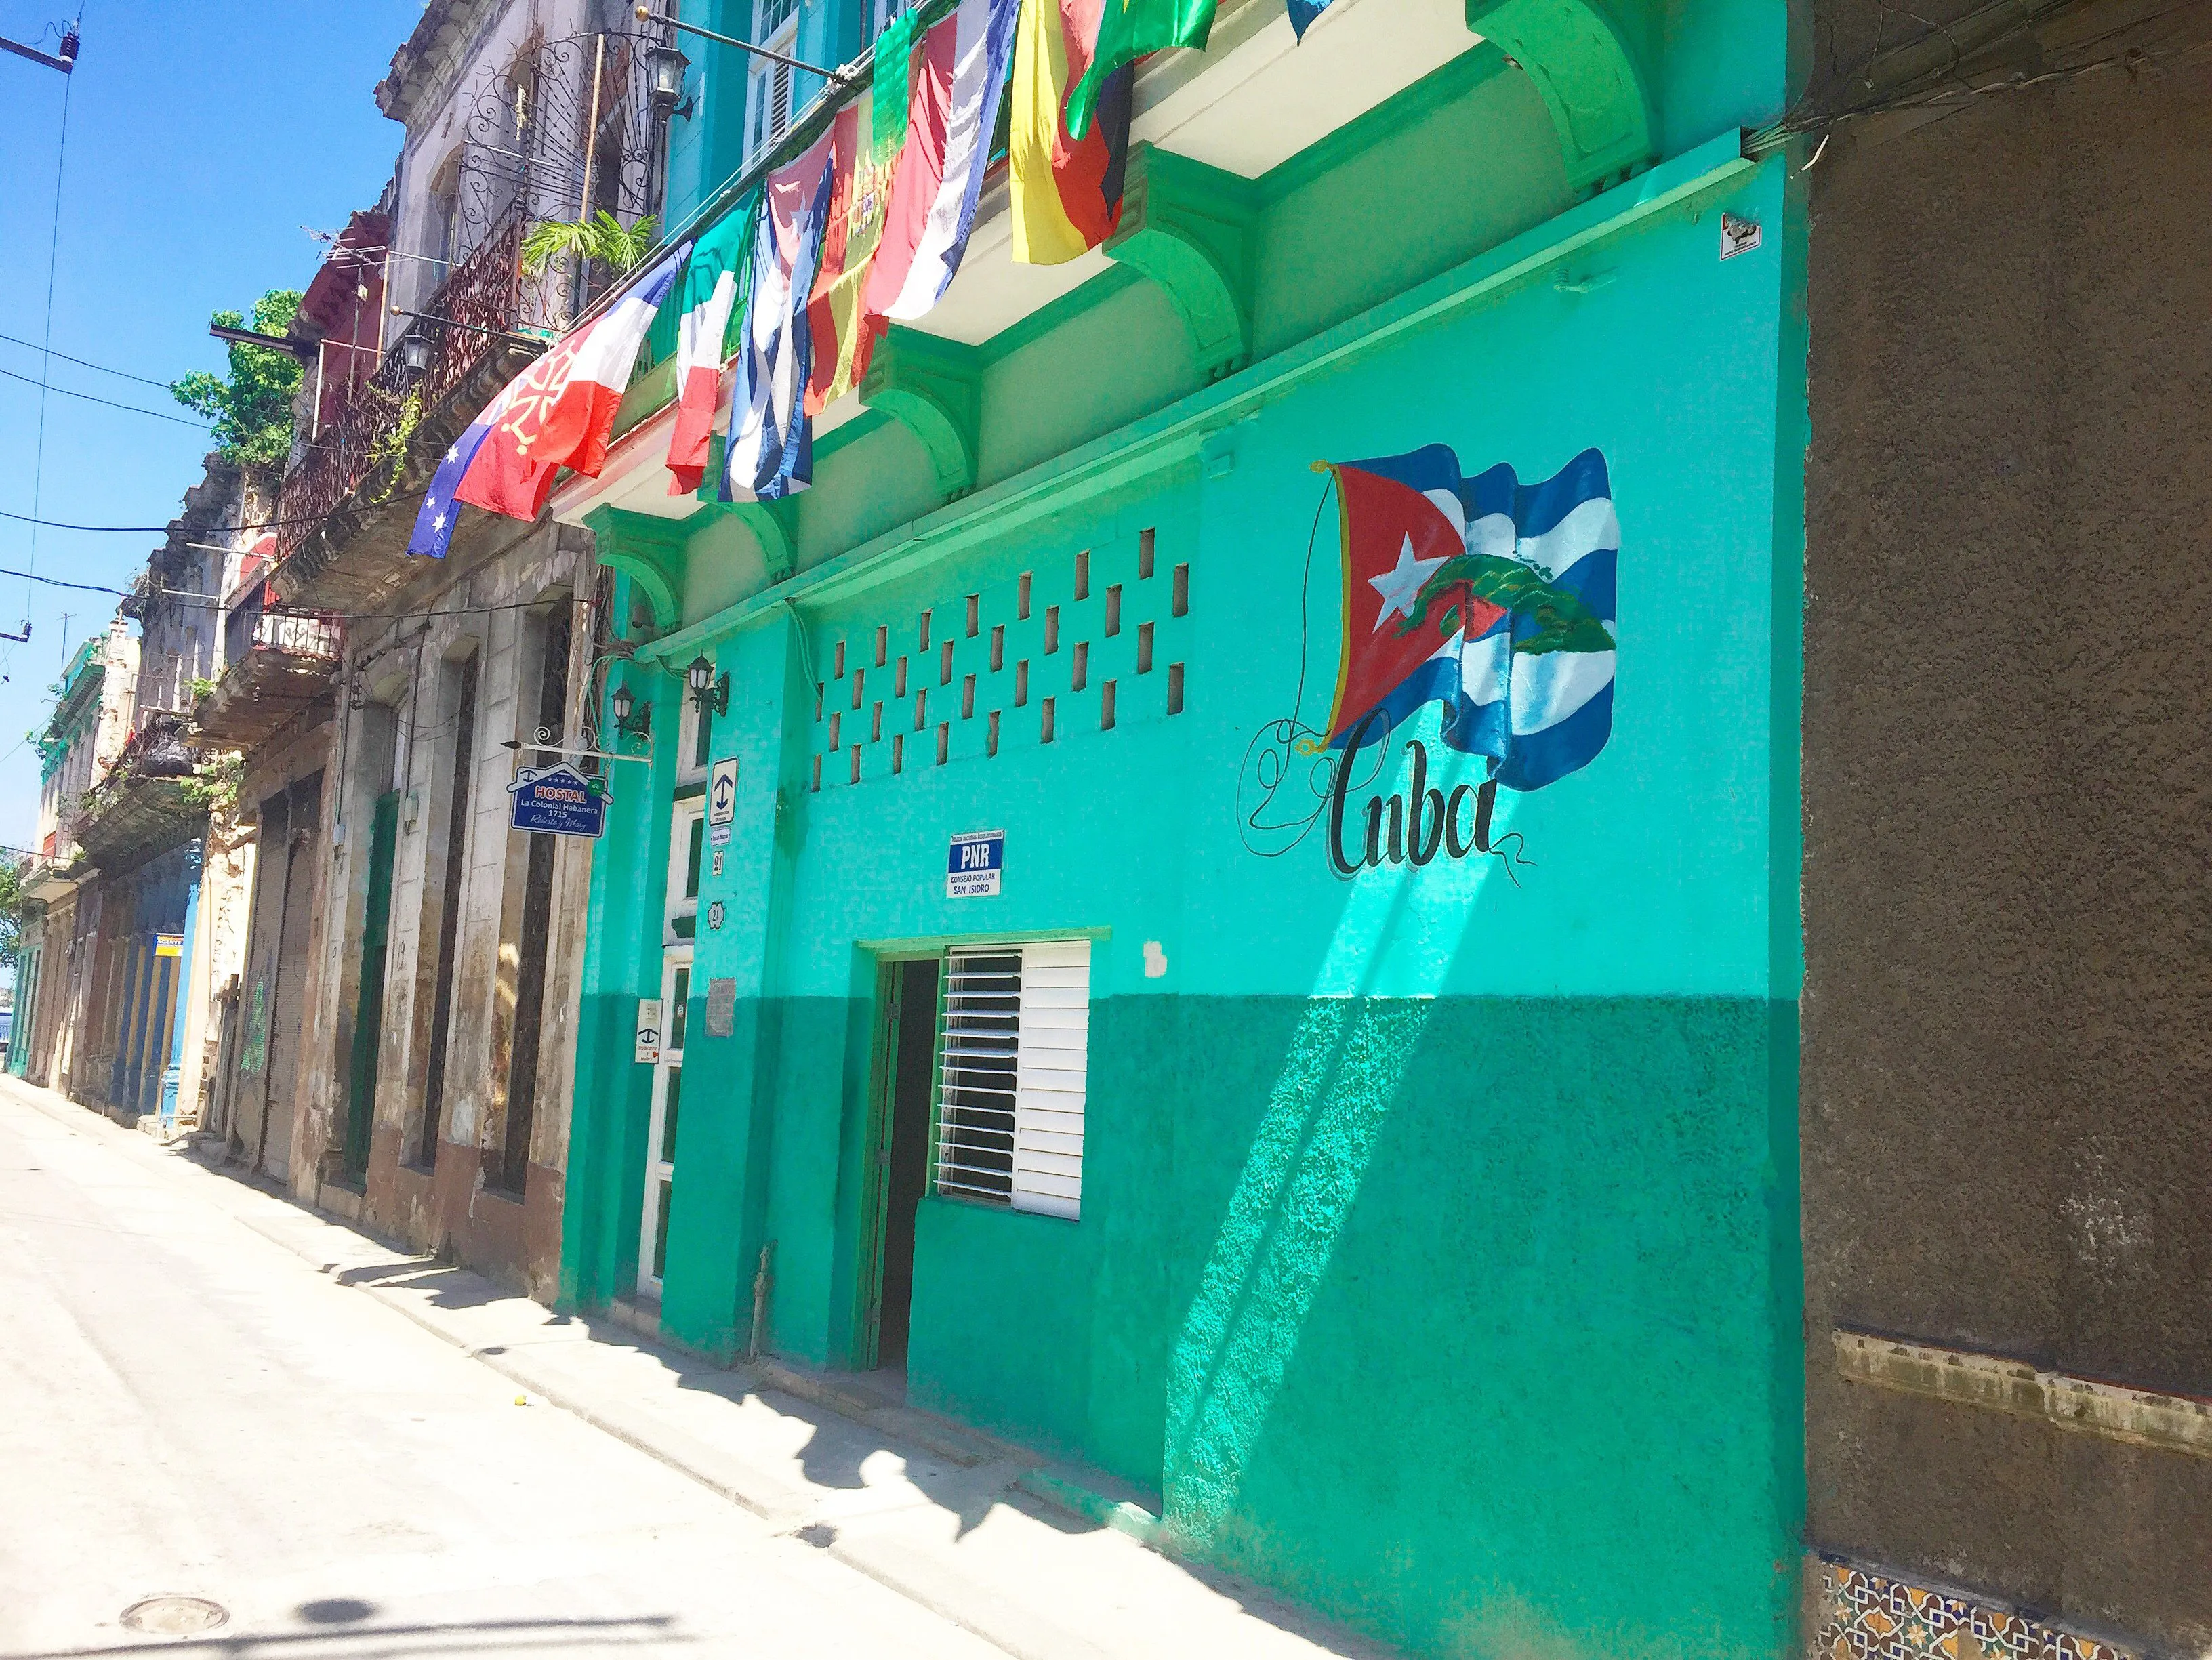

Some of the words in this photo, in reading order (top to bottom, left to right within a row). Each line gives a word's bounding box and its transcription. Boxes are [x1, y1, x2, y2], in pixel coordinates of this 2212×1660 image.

[535, 785, 587, 804] HOSTAL
[1325, 707, 1498, 881] Cuba
[531, 800, 562, 810] Colonial
[563, 804, 598, 814] Habanera
[548, 810, 567, 818] 1715
[714, 855, 722, 871] 21
[961, 844, 989, 869] PNR
[951, 875, 972, 884] CONSEJO
[972, 873, 995, 881] POPULAR
[953, 886, 966, 894] SAN
[969, 884, 989, 894] ISIDRO
[712, 909, 719, 921] 21
